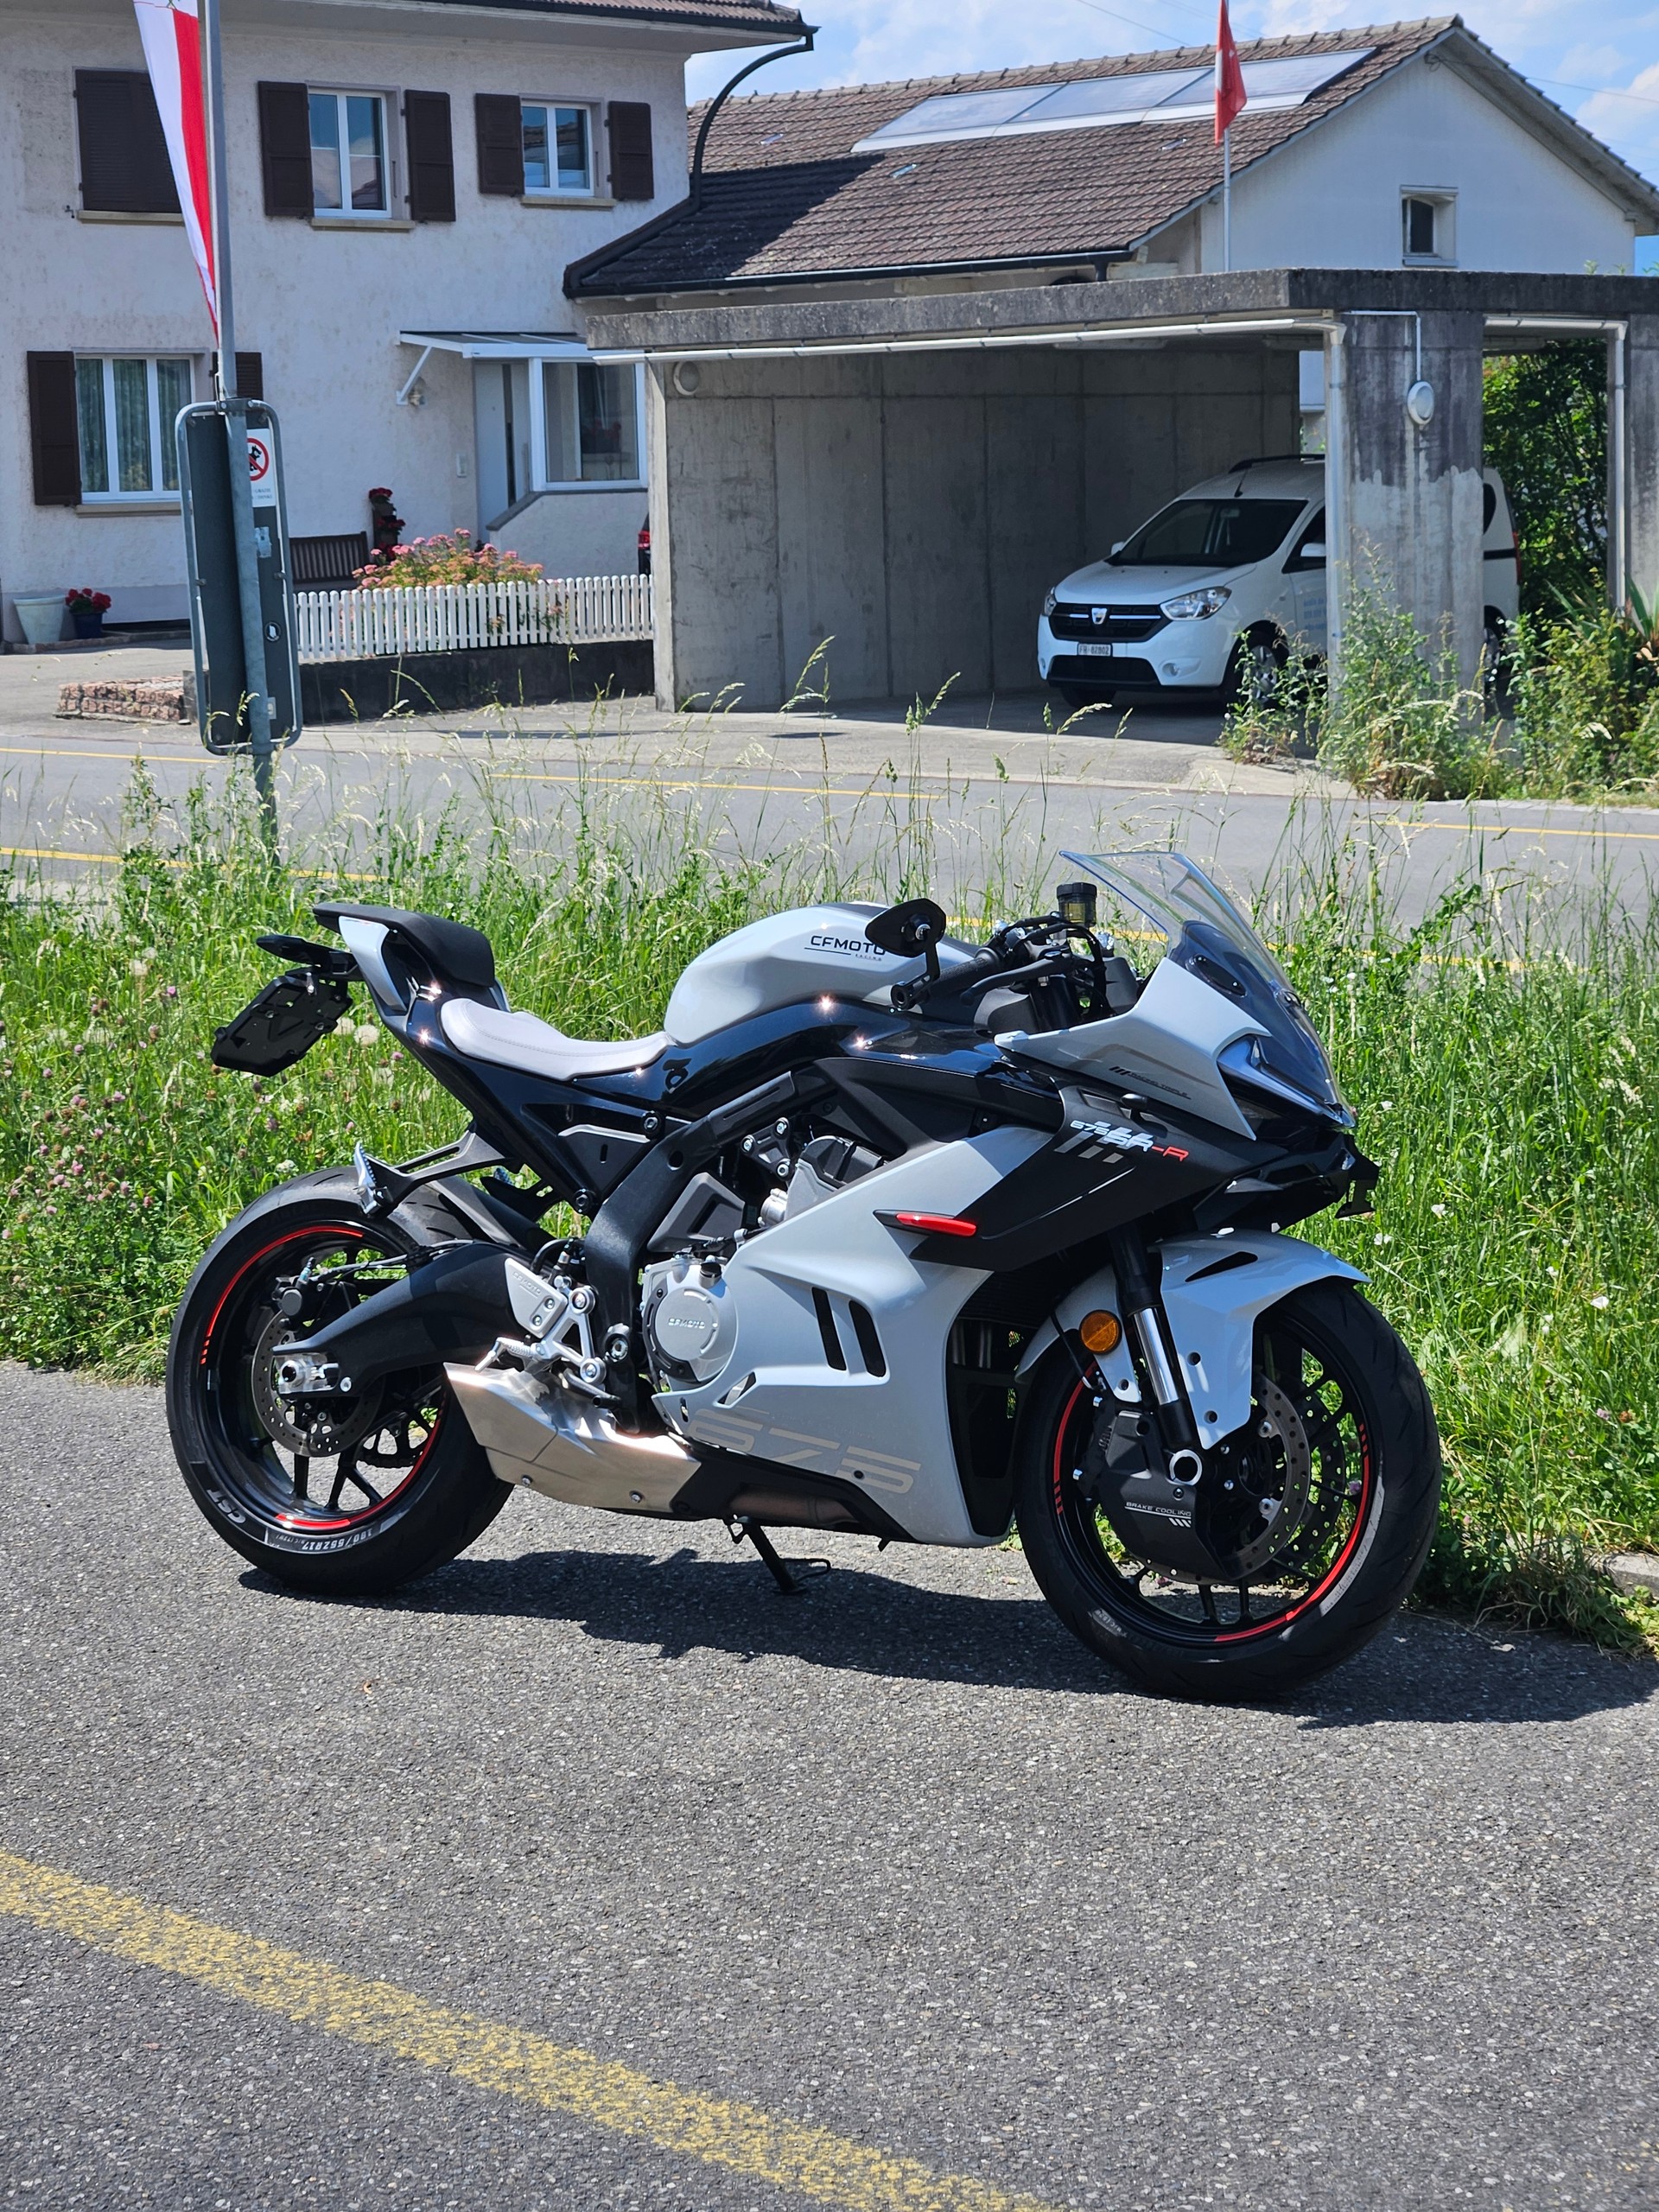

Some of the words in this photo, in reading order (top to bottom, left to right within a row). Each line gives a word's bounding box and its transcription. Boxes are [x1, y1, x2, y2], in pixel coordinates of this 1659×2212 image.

[810, 935, 886, 956] CFMOTO
[512, 1271, 542, 1295] CFMOTO
[668, 1318, 705, 1329] CFMOTO
[207, 1489, 245, 1523] CST
[1126, 1502, 1153, 1511] BRAKE
[1155, 1506, 1192, 1516] COOLING
